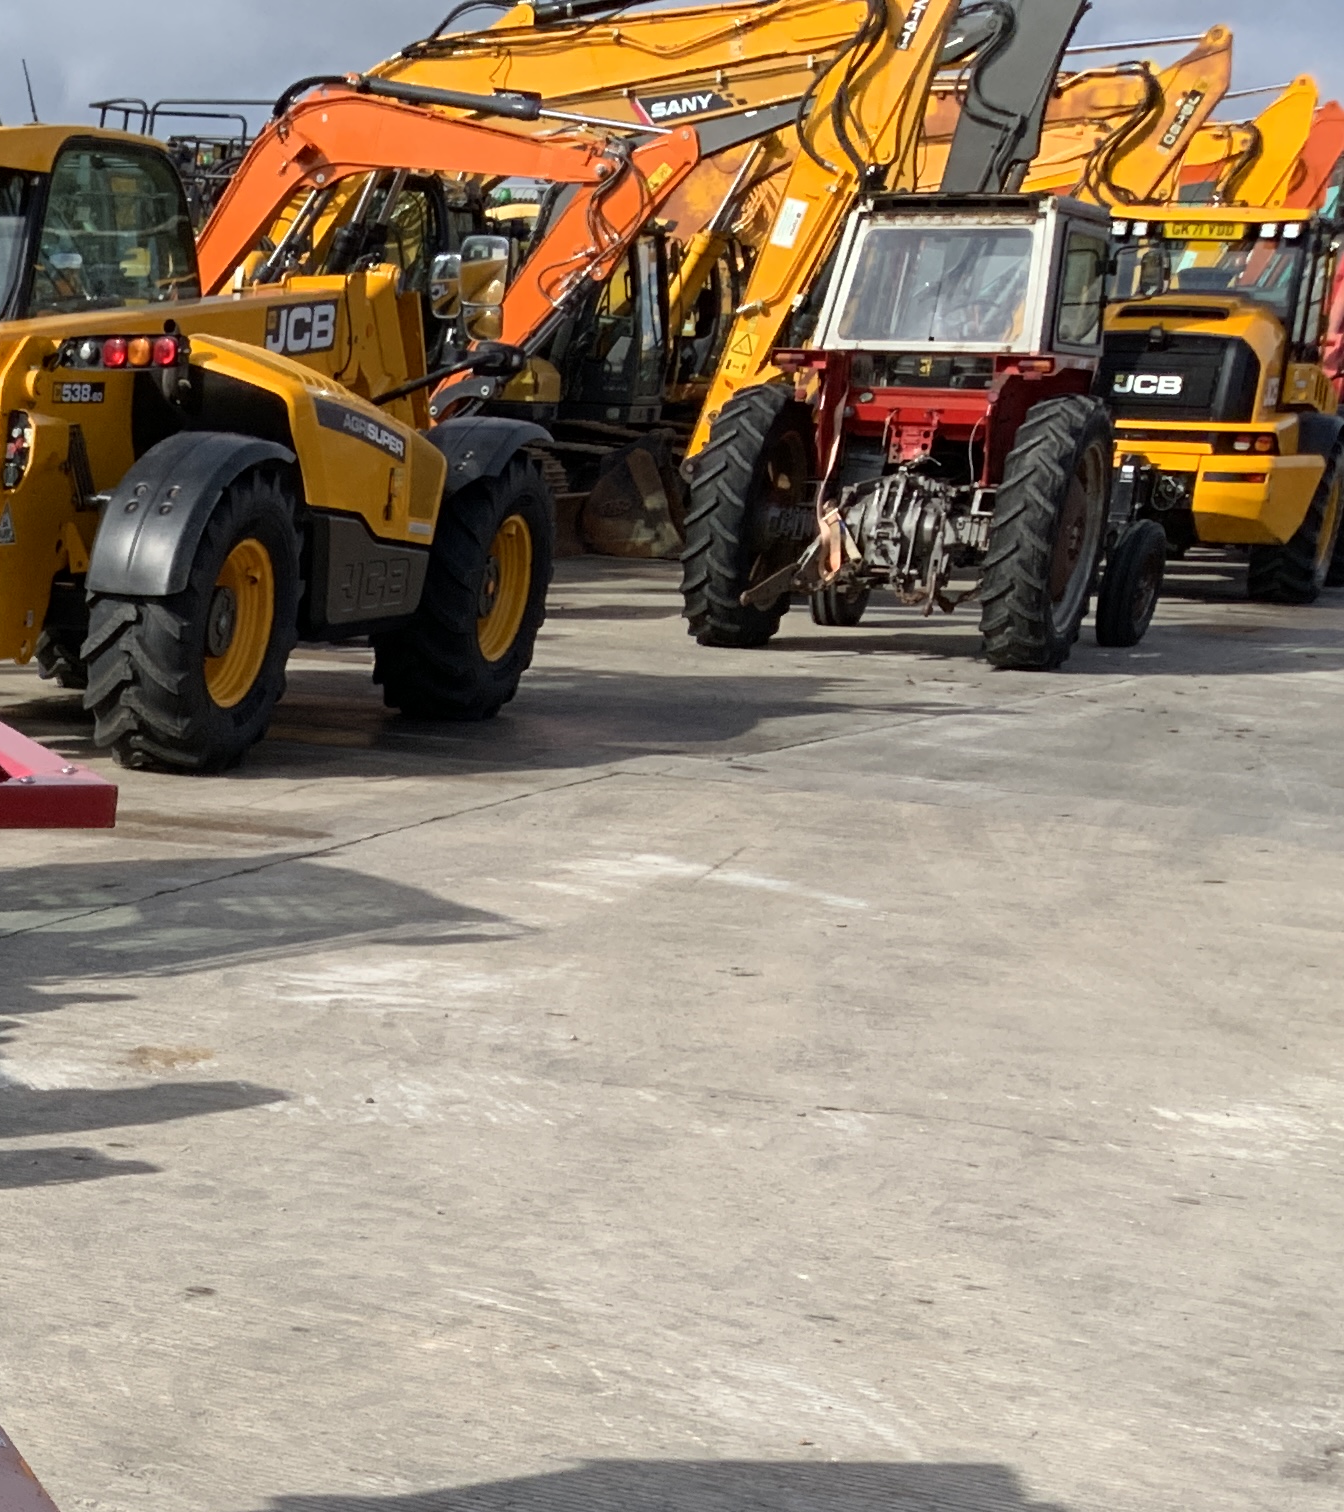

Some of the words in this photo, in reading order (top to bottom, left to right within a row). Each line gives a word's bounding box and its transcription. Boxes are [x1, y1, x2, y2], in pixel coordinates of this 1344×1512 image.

[650, 93, 713, 119] SANY
[266, 304, 335, 354] JCB
[1113, 374, 1183, 395] JCB
[342, 413, 404, 457] AGRISUPER
